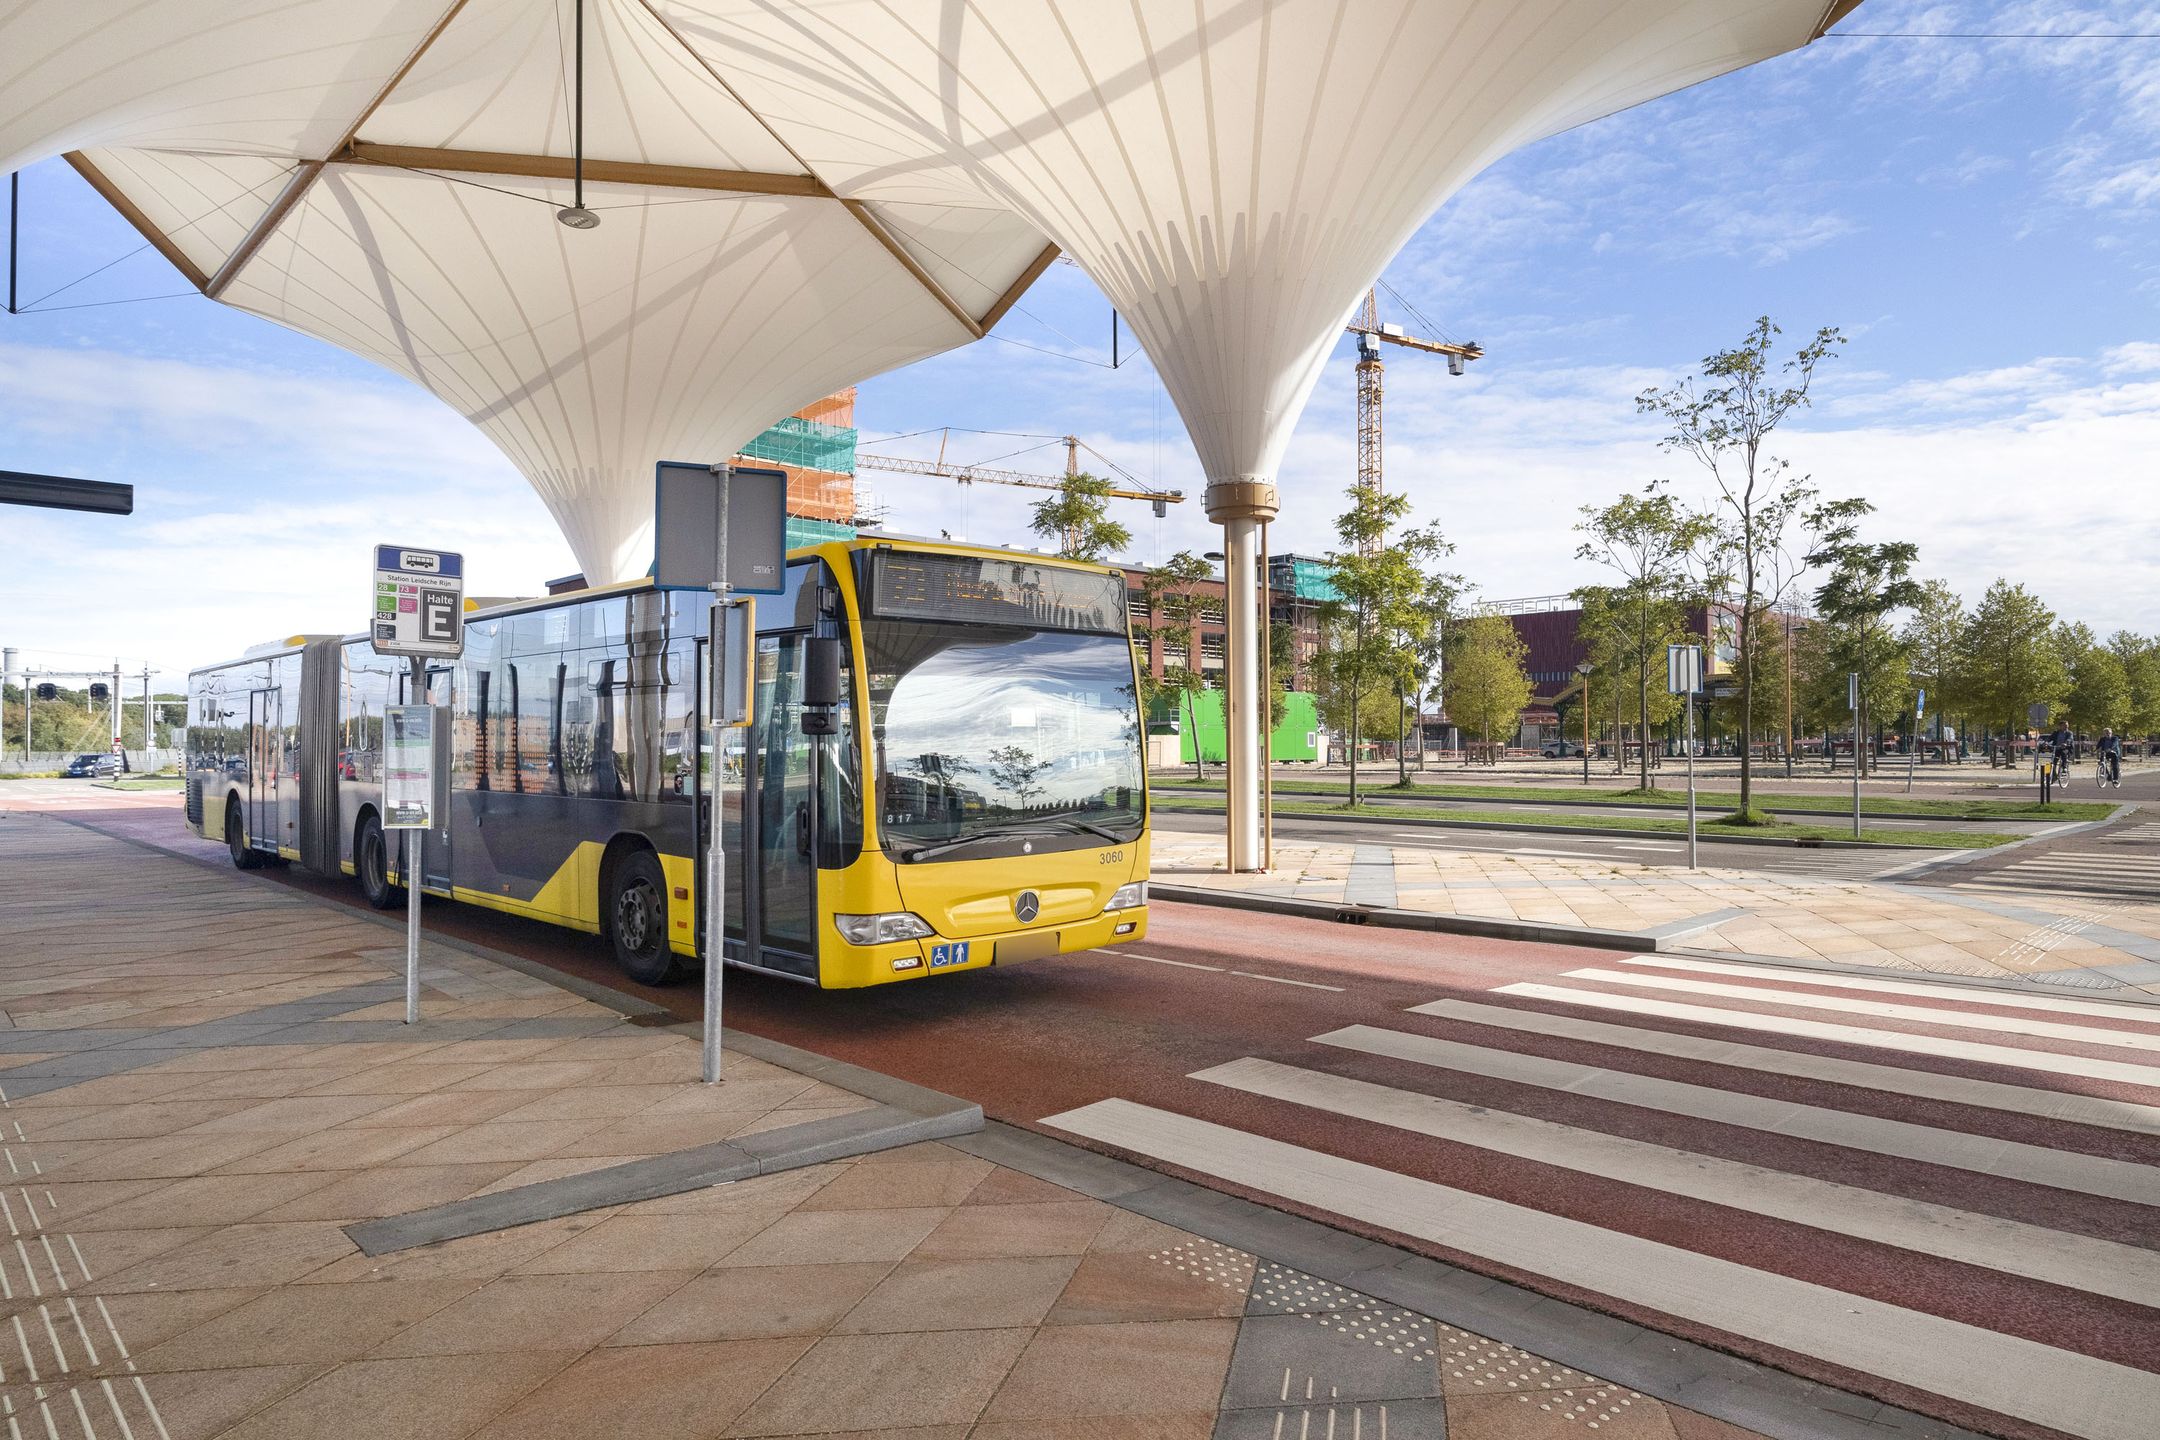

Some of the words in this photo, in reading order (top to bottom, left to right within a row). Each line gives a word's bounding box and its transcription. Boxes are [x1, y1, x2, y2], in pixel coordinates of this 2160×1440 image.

[387, 575, 409, 583] Station
[411, 577, 437, 586] Leidsche
[439, 579, 451, 587] Rijn
[427, 594, 453, 605] Halte
[377, 612, 392, 620] 428
[428, 605, 451, 638] E
[1100, 850, 1123, 864] 3060
